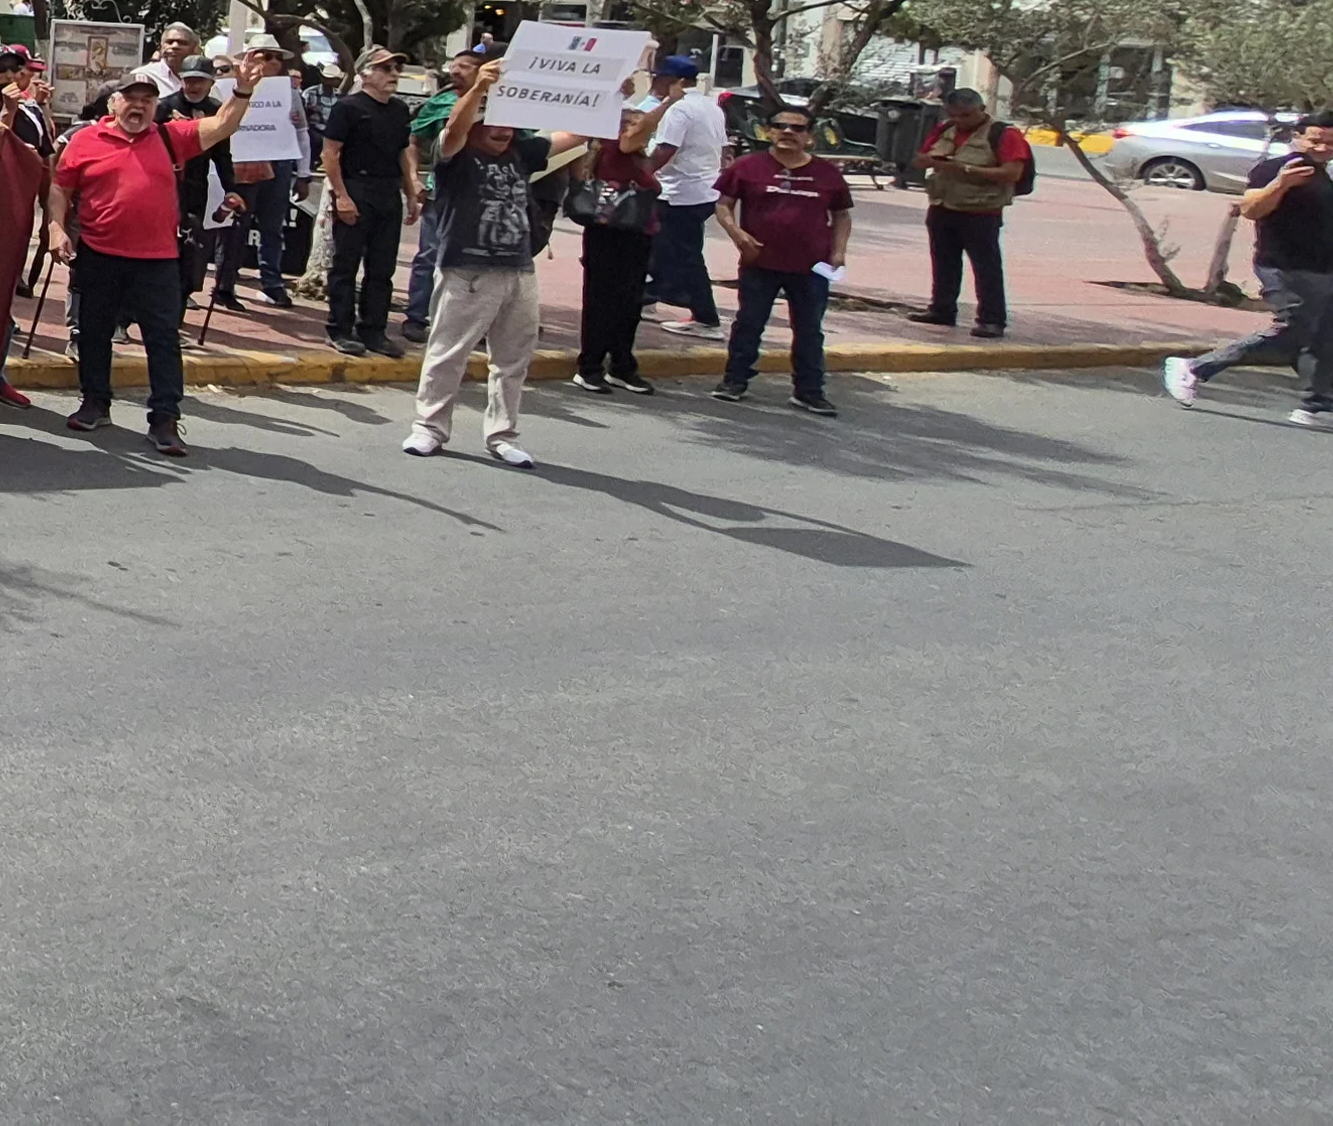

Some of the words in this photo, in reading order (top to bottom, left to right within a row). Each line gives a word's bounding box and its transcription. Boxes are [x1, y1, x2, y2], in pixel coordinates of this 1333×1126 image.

[528, 56, 577, 73] ¡VIVA
[582, 62, 602, 75] LA
[273, 100, 282, 108] LA
[496, 84, 600, 108] SOBERANÍA!
